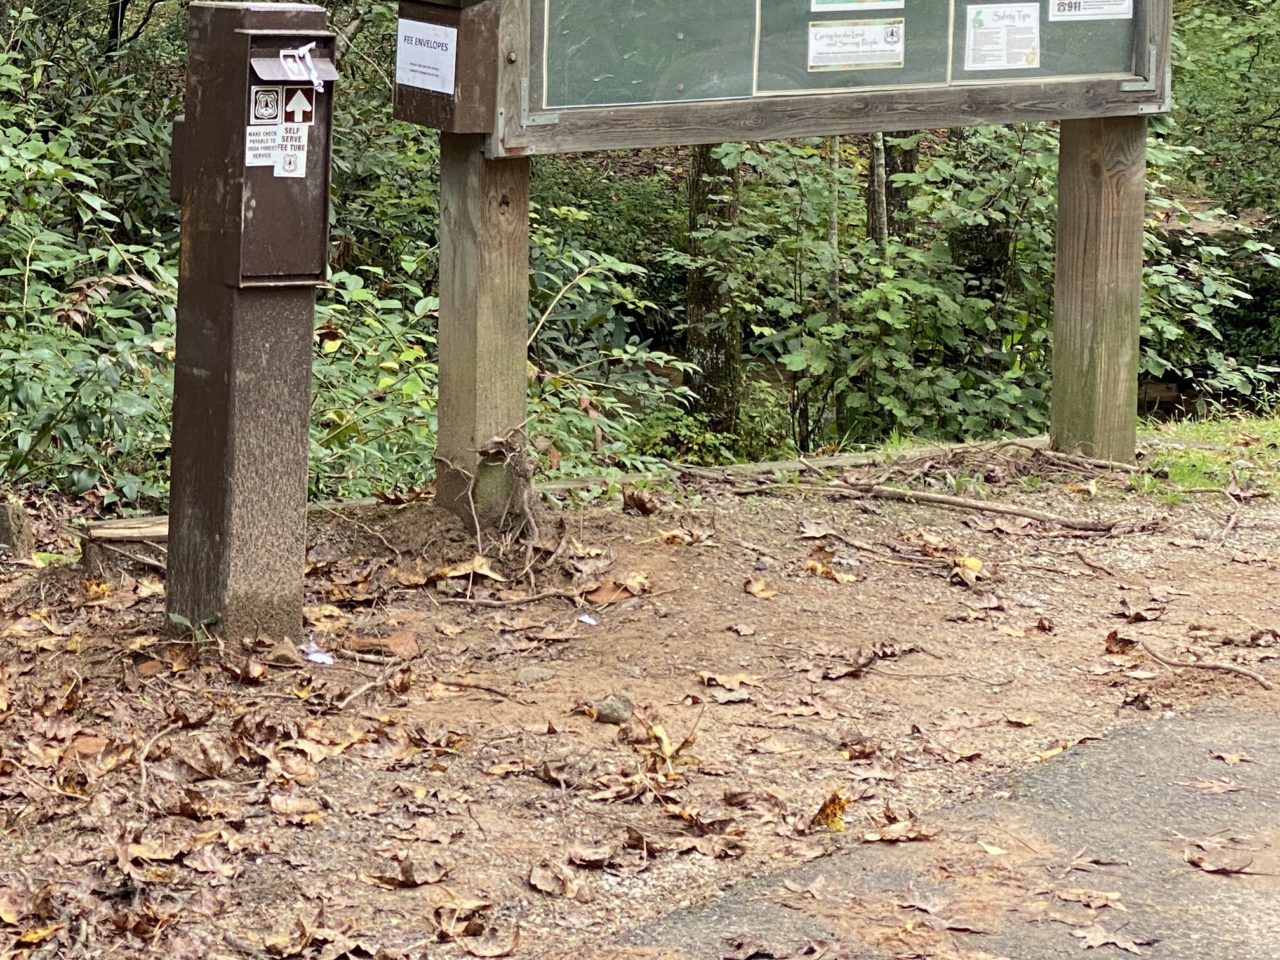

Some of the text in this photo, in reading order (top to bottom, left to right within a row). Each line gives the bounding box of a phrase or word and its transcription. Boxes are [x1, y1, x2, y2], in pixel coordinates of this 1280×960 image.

[1067, 1, 1081, 11] 911
[404, 36, 448, 51] FEE ENVELOPES
[284, 127, 301, 135] SELF
[281, 135, 302, 143] SERVE
[277, 143, 306, 152] FEE TUBE
